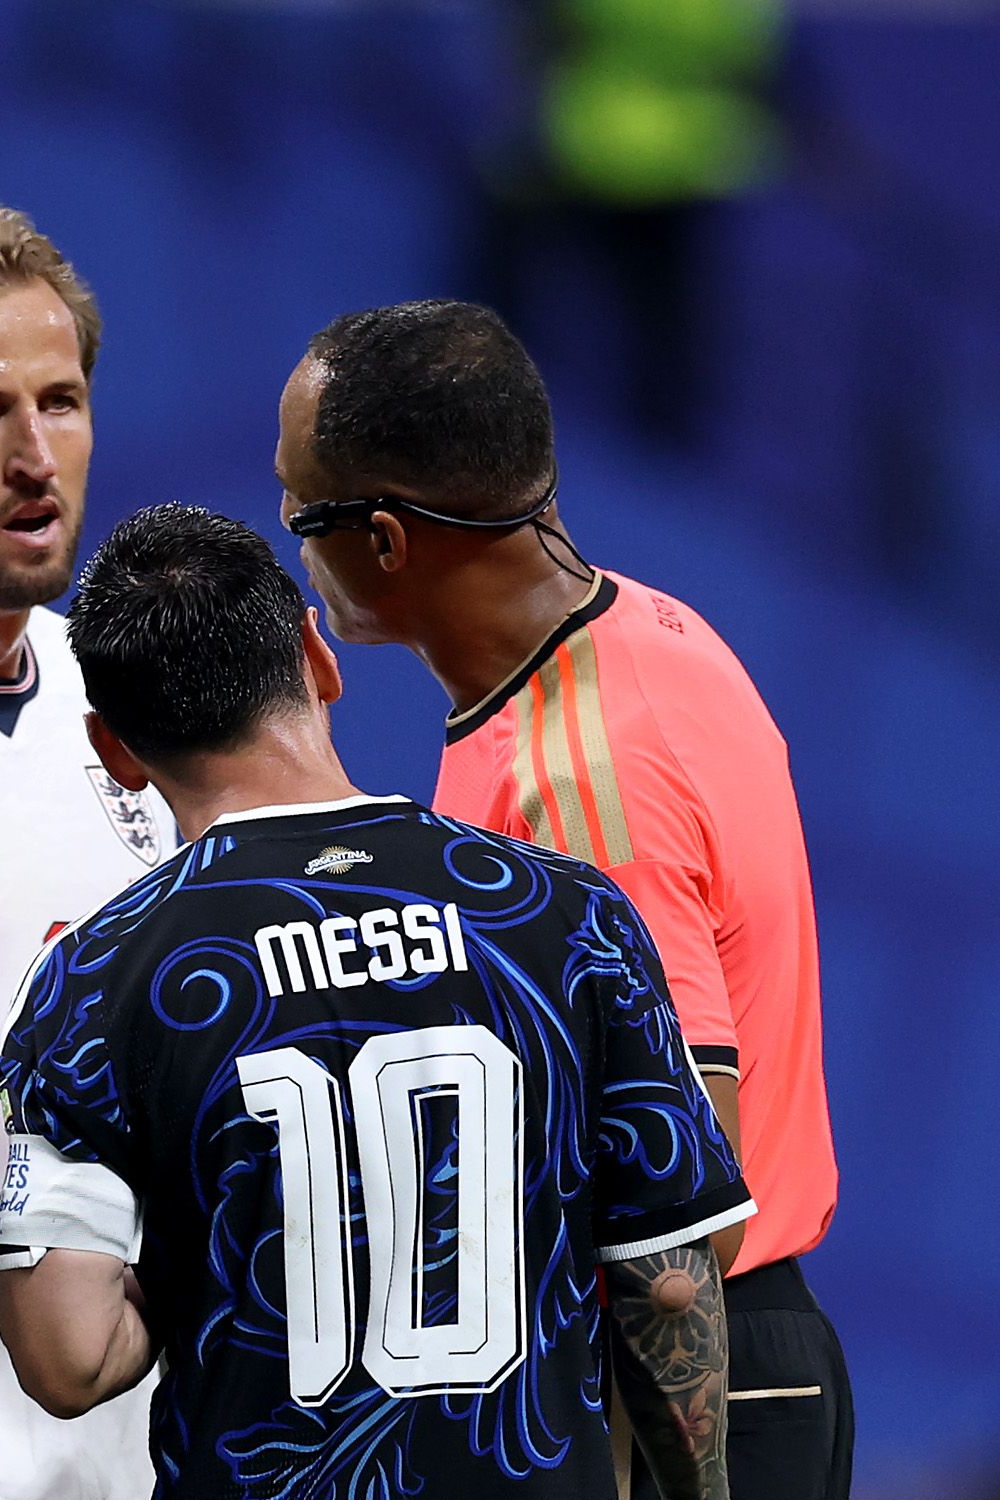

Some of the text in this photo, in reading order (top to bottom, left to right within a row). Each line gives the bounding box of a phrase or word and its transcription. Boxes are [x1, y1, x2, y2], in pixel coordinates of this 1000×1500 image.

[306, 850, 371, 872] ARGENTINA
[254, 902, 468, 997] MESSI
[235, 1025, 527, 1407] 10
